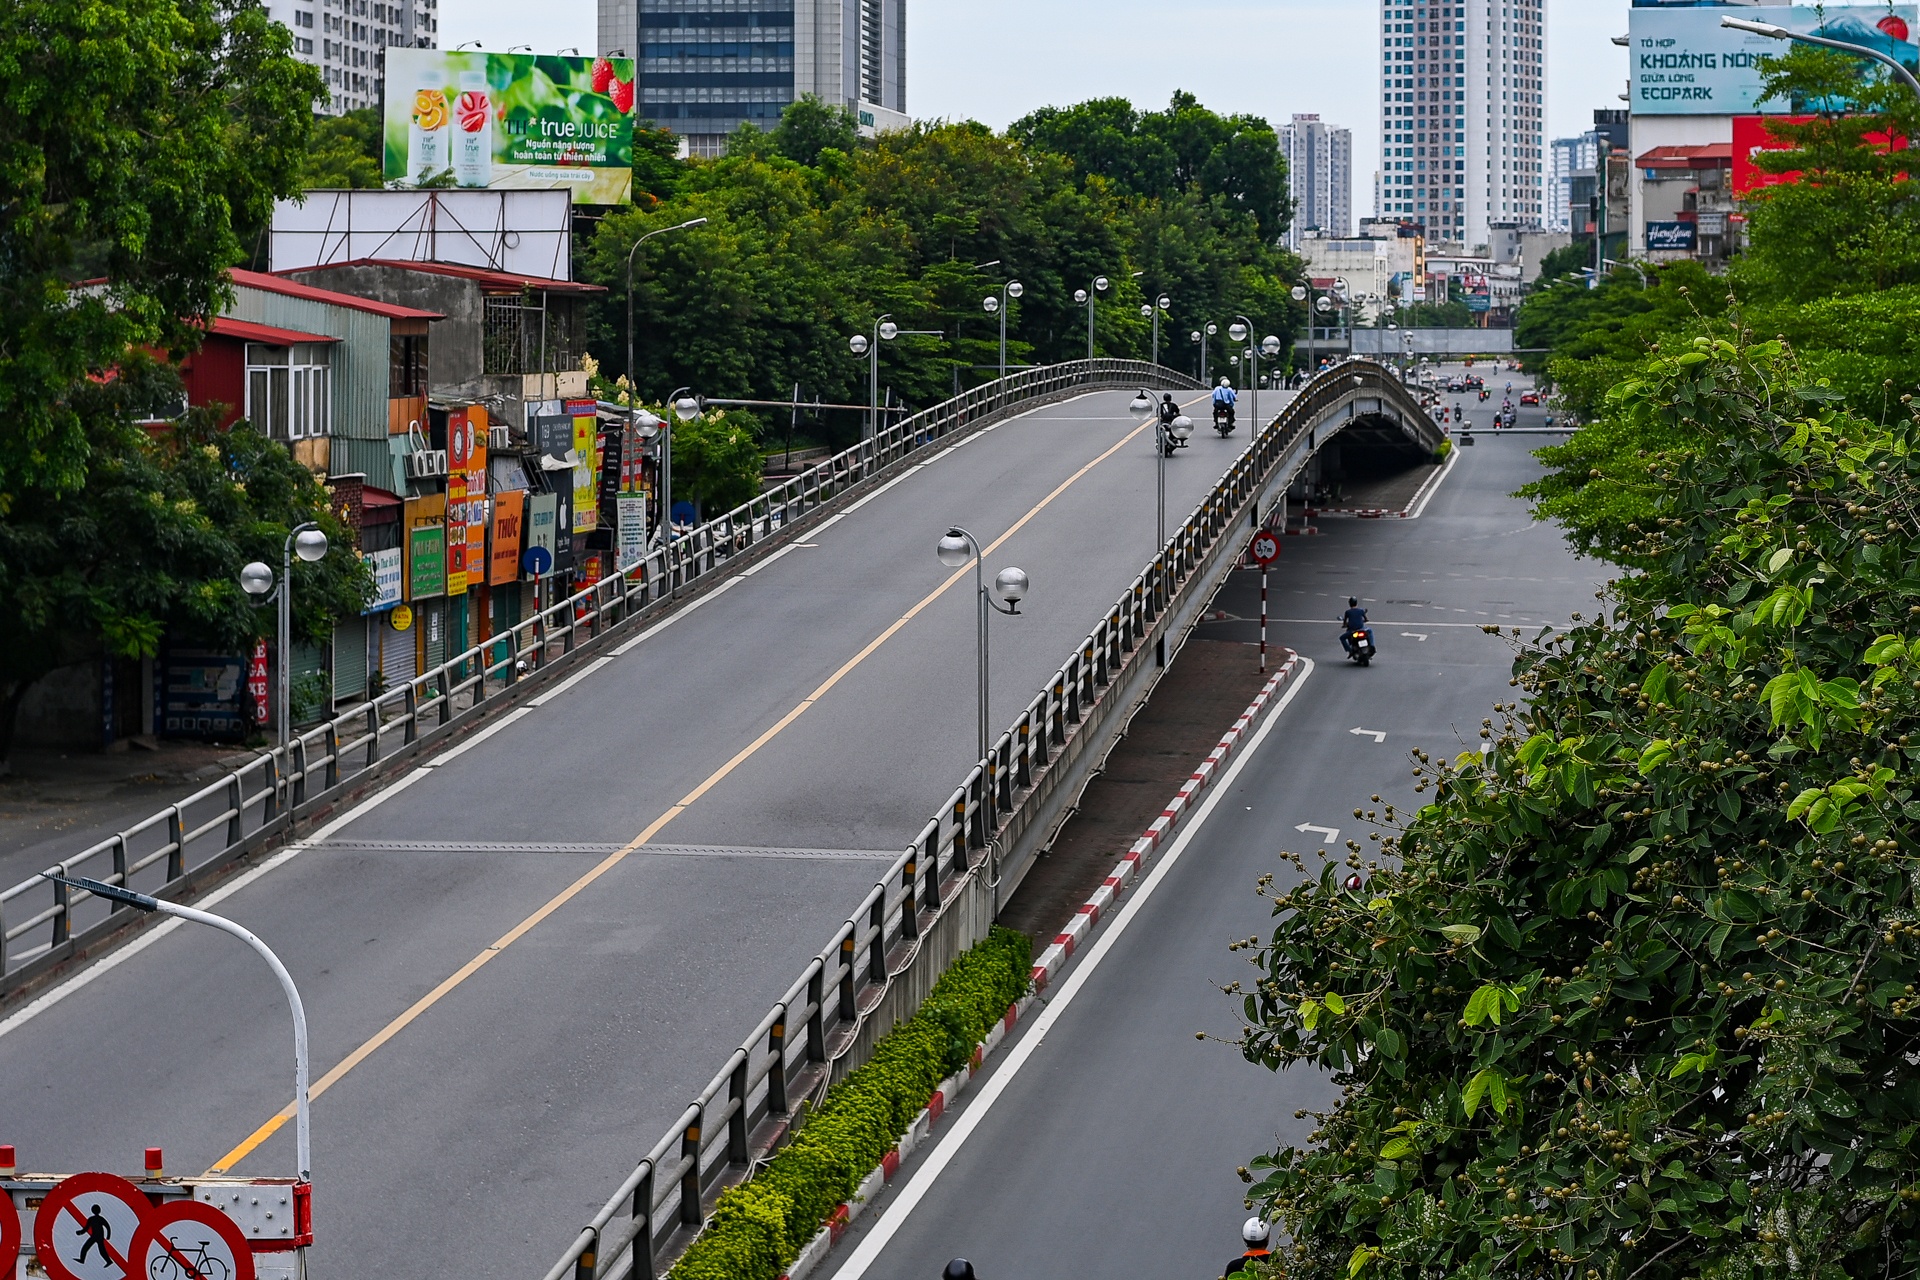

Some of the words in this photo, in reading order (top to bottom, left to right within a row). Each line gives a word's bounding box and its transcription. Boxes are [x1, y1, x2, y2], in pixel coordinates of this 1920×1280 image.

[1656, 38, 1676, 49] HỢP
[1640, 49, 1716, 69] KHOÁNG
[1641, 71, 1665, 83] GIỮA
[1641, 87, 1712, 100] ECOPARK
[540, 117, 575, 137] true
[578, 123, 618, 138] JUICE
[526, 139, 551, 150] Nguồn
[553, 140, 572, 150] năng
[573, 140, 595, 152] lượng
[514, 150, 533, 160] hoàn
[535, 151, 552, 160] toàn
[553, 152, 563, 160] từ
[563, 152, 583, 161] thiên
[585, 153, 606, 162] nhiên
